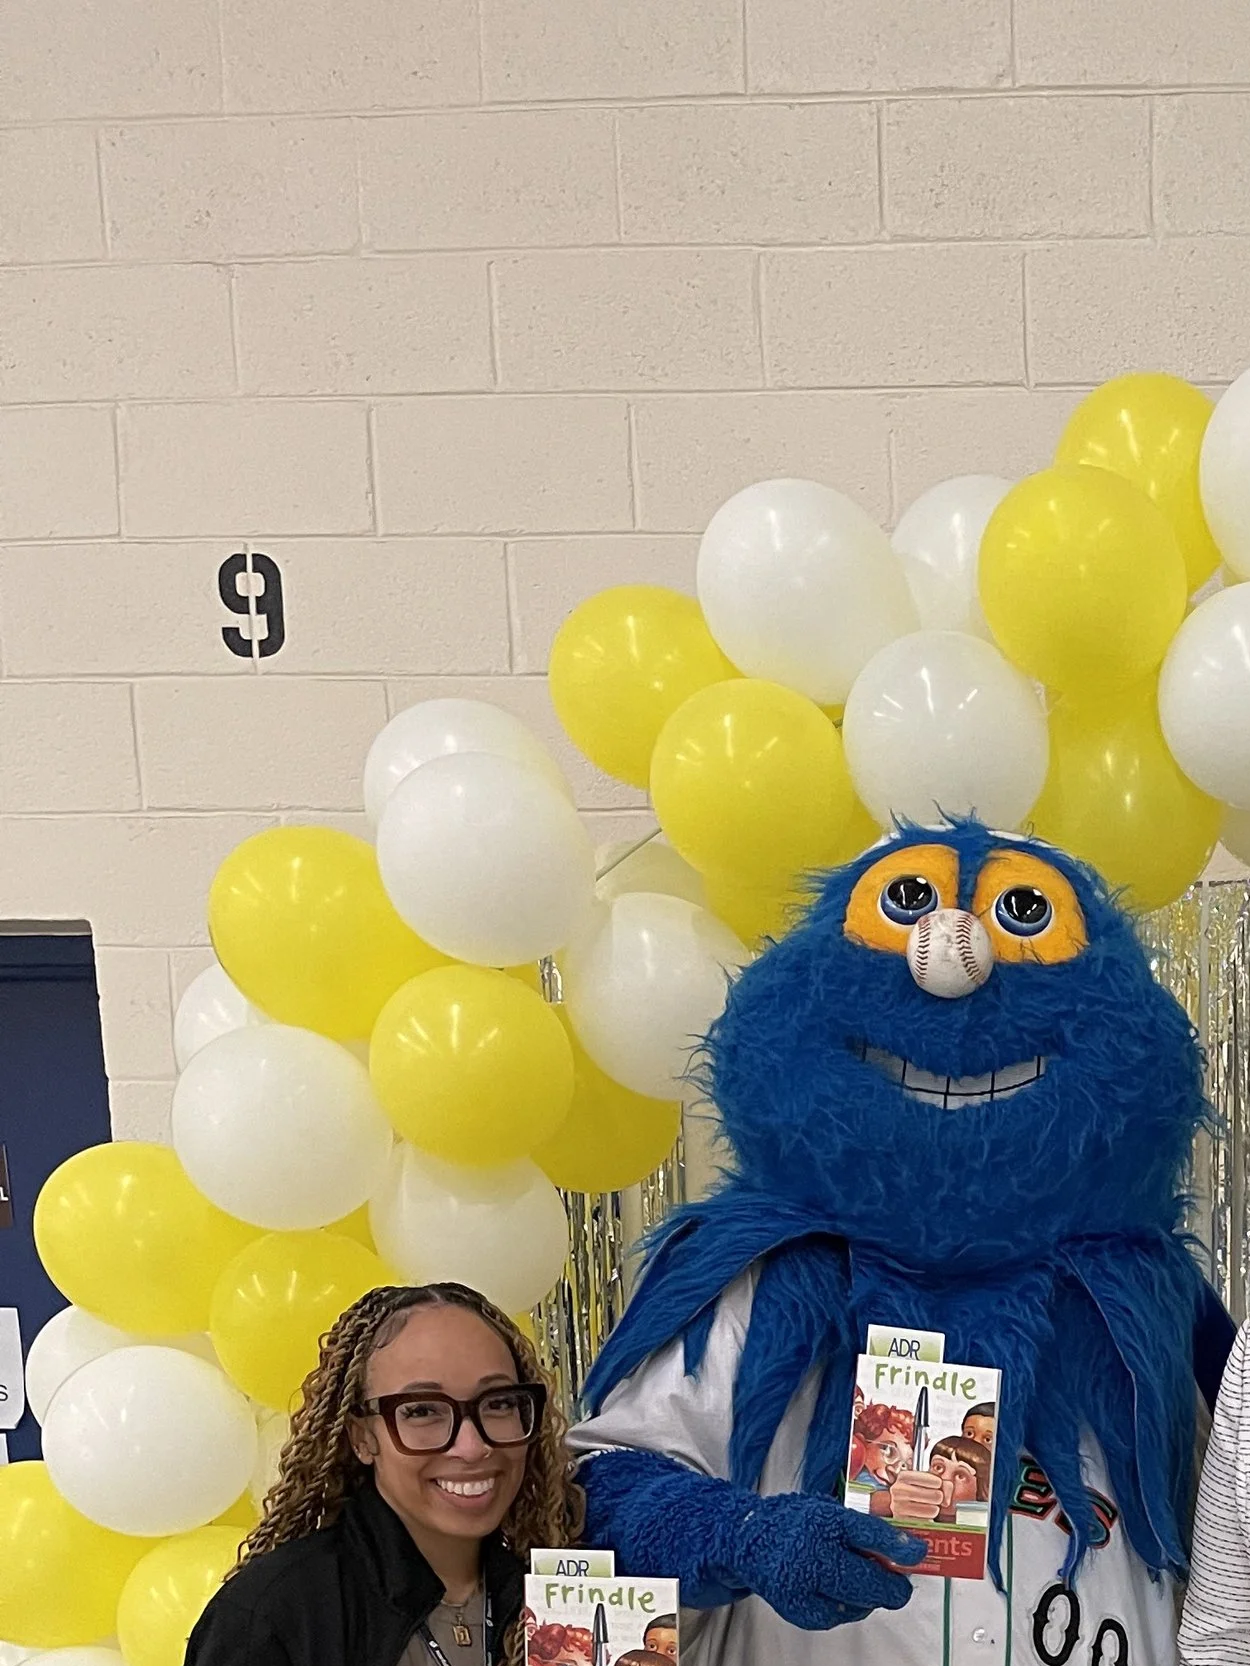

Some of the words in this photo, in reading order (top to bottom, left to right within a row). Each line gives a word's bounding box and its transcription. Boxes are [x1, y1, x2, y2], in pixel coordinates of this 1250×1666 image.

[218, 553, 285, 659] 9
[887, 1337, 921, 1360] ADR
[874, 1363, 977, 1400] Frindle
[923, 1536, 973, 1556] ents
[555, 1559, 590, 1577] ADR
[545, 1583, 656, 1614] Frindle
